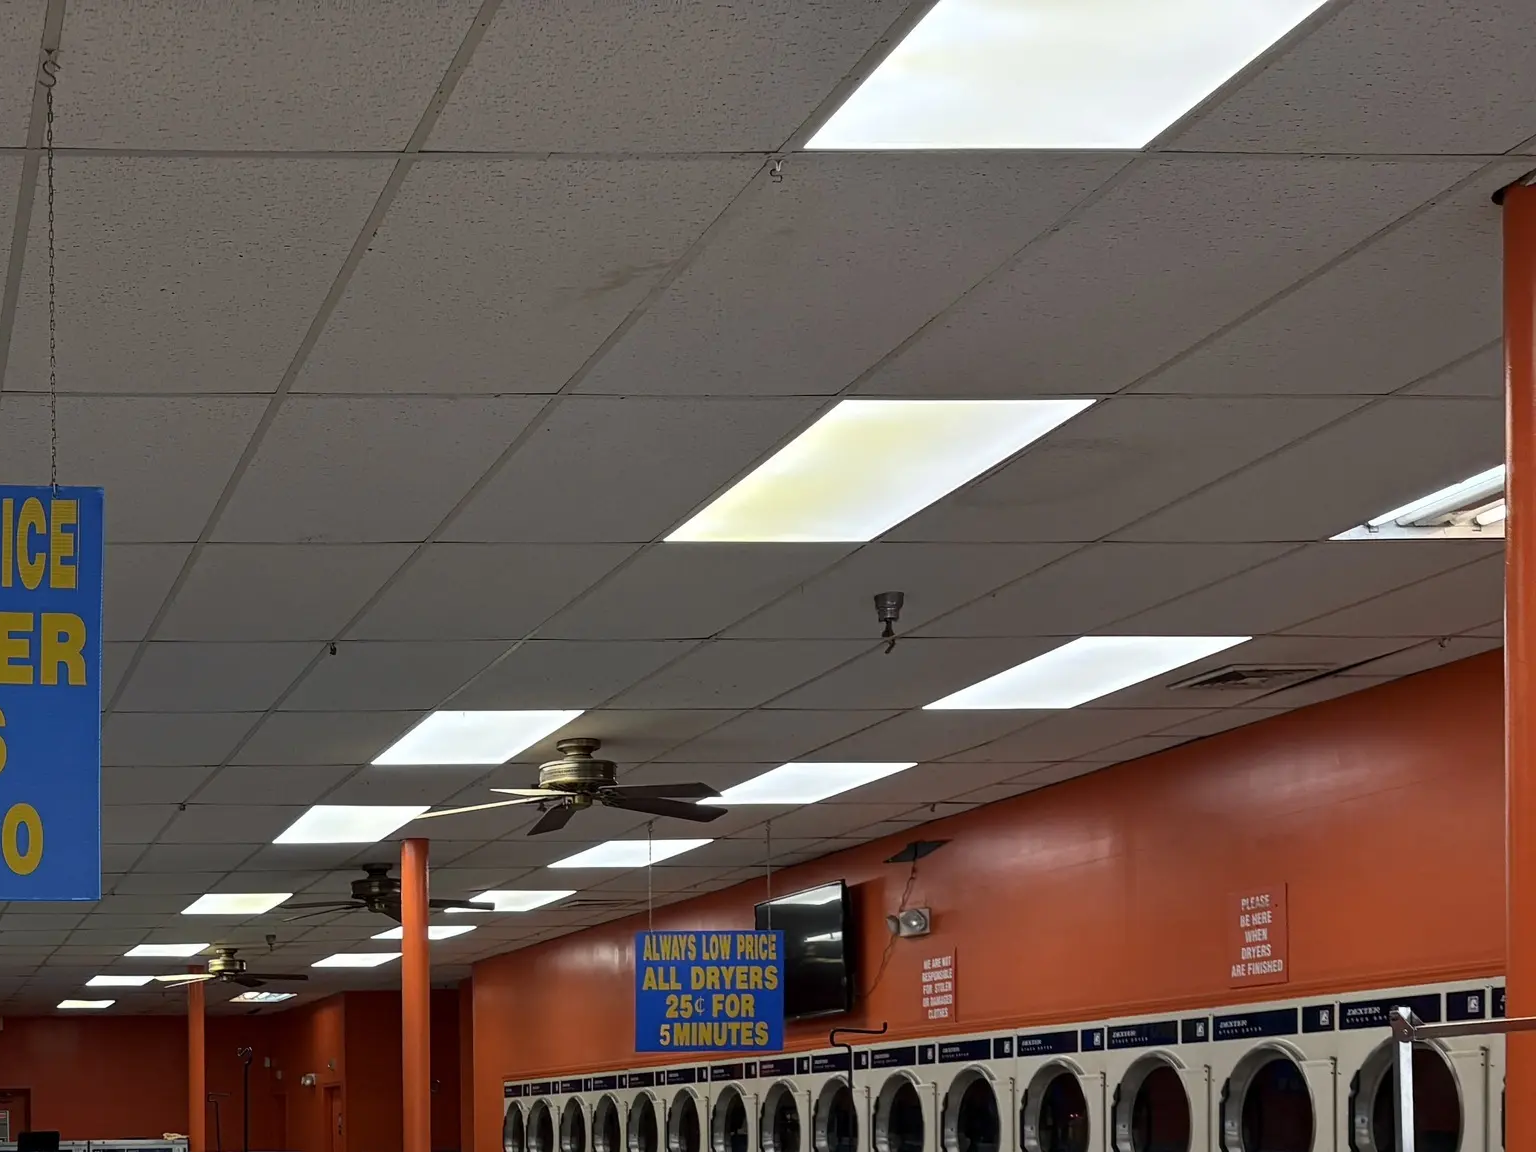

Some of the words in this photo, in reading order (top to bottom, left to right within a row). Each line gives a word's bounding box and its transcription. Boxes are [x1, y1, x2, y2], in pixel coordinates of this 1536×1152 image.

[1241, 895, 1270, 911] PLEASE
[1240, 915, 1251, 927] BE
[1252, 911, 1272, 926] HERE
[1245, 928, 1267, 943] WHEN
[644, 935, 696, 961] ALWAYS
[702, 935, 731, 960] LOW
[737, 934, 776, 960] PRICE
[1242, 944, 1271, 960] DRYERS
[932, 957, 941, 968] ARE
[1232, 964, 1246, 978] ARE
[1248, 959, 1283, 975] FINISHED
[643, 966, 682, 990] ALL
[691, 966, 778, 990] DRYERS
[923, 985, 932, 995] FOR
[666, 994, 705, 1019] 25¢
[712, 994, 755, 1018] FOR
[1347, 1007, 1381, 1016] DEXTER
[1219, 1020, 1247, 1028] DEXTER
[660, 1024, 670, 1046] 5
[674, 1022, 768, 1046] MINUTES
